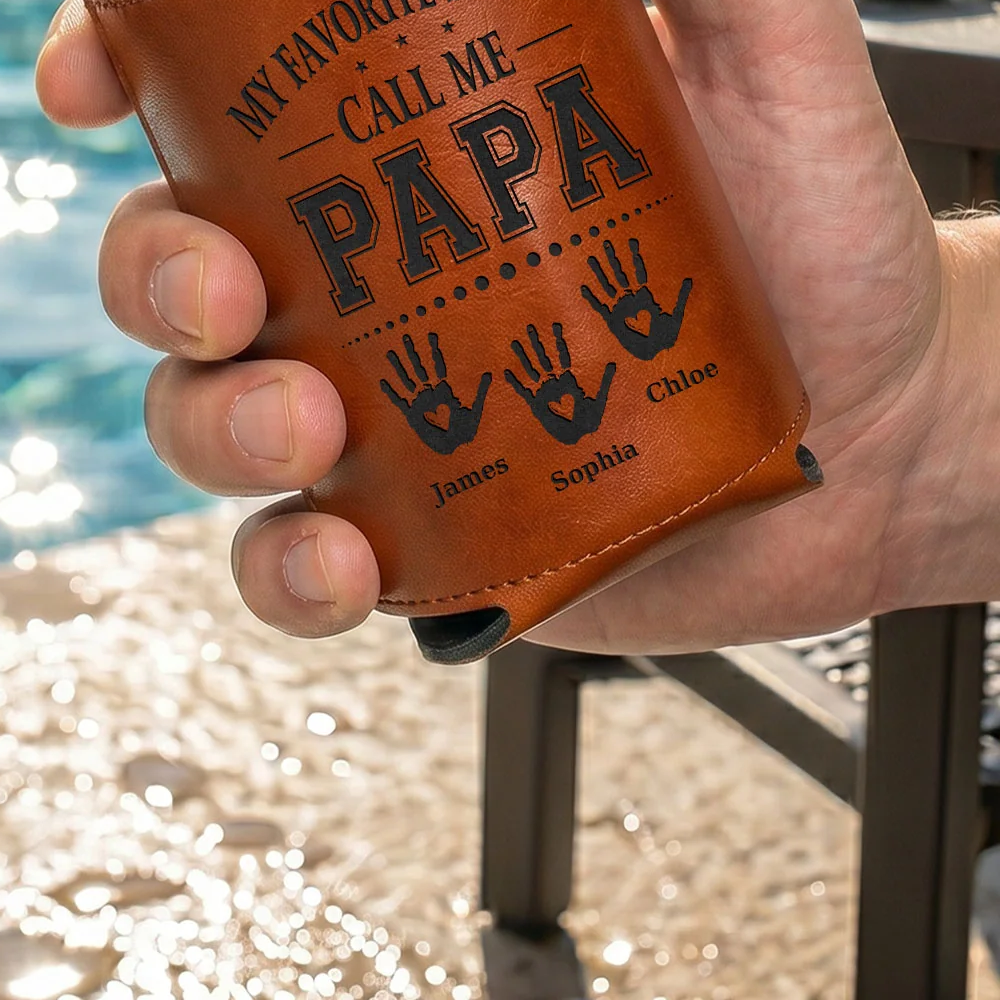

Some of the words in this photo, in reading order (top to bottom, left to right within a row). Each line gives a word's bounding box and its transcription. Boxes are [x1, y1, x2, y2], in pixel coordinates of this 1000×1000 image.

[225, 65, 289, 143] MY
[337, 65, 446, 144] CALL
[441, 30, 516, 97] ME
[286, 64, 652, 317] PAPA
[646, 360, 719, 403] Chloe
[430, 456, 510, 508] James
[550, 440, 639, 492] Sophia
